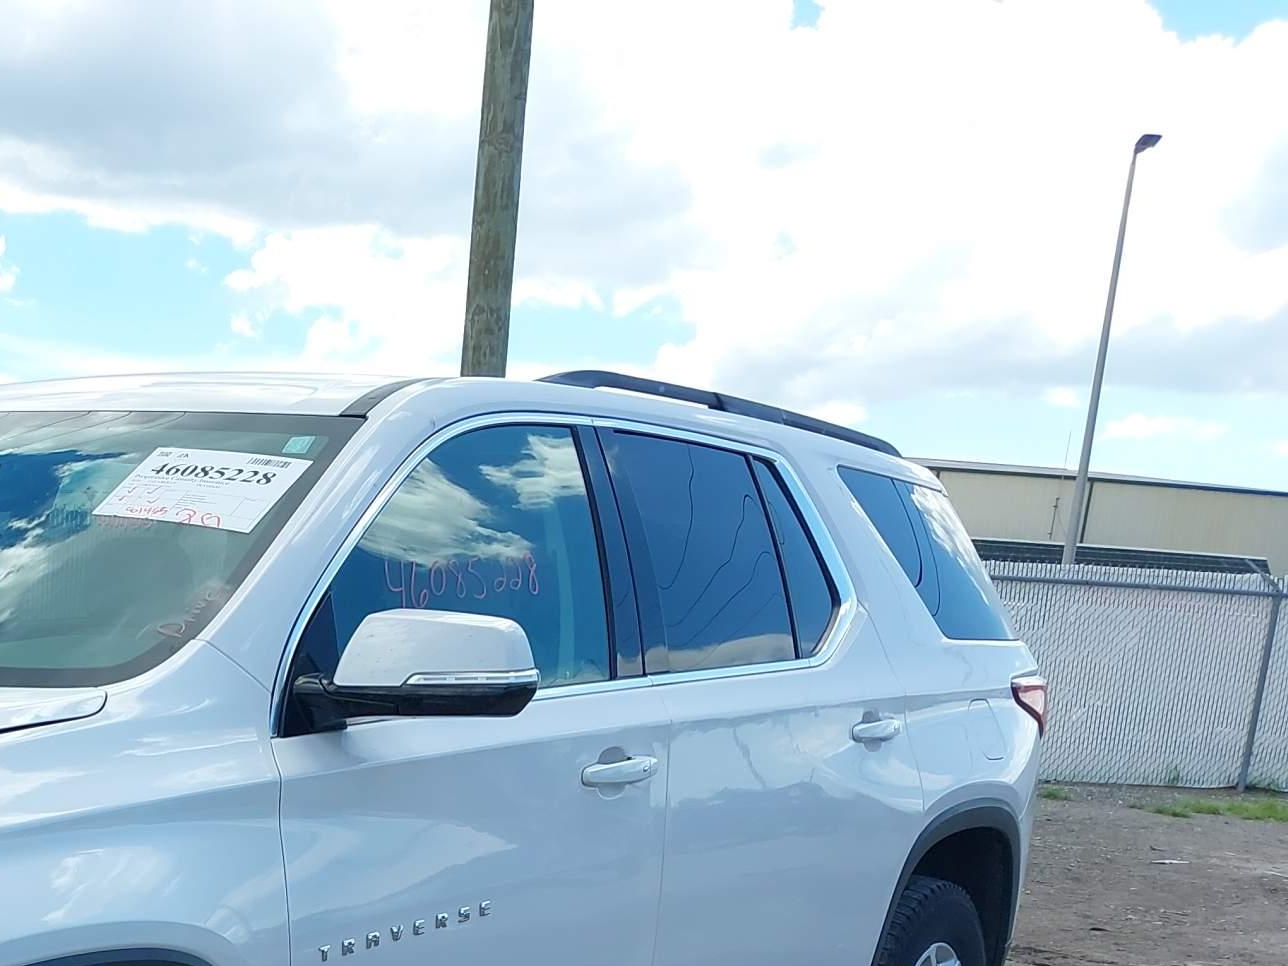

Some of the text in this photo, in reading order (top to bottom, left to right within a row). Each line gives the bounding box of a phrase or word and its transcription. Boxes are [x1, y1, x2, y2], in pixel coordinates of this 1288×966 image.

[150, 462, 277, 486] 46085228
[384, 551, 539, 609] 46085228
[317, 898, 493, 963] TRAVERSE
